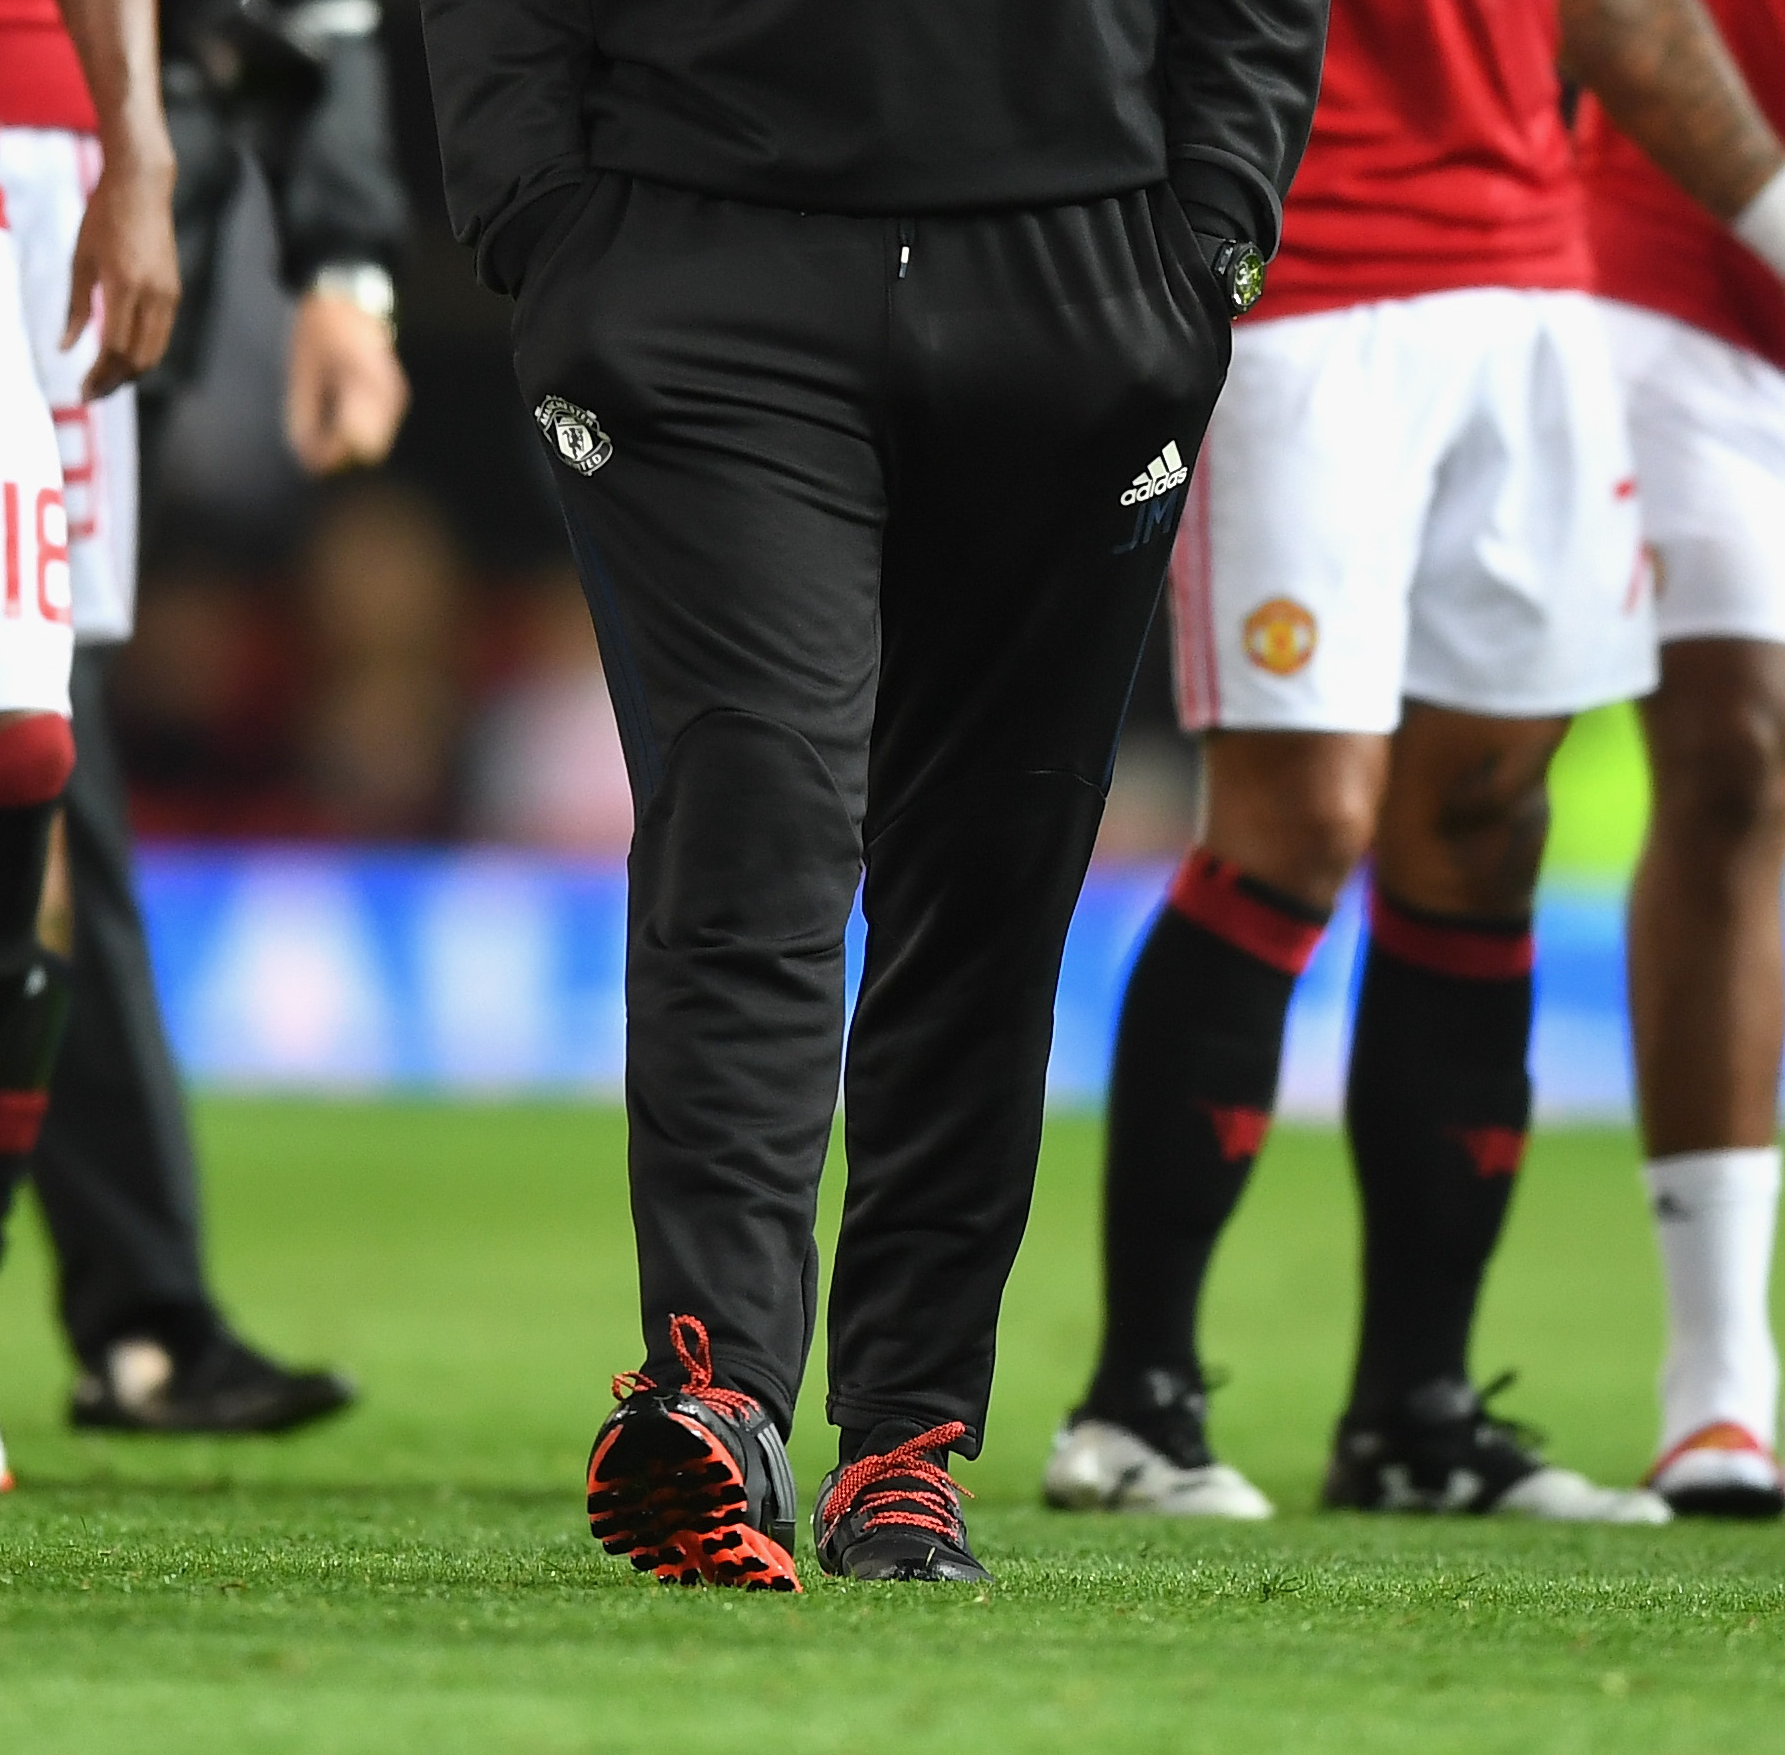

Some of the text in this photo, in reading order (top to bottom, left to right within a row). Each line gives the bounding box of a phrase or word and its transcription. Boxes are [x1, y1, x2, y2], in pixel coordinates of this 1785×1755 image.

[1119, 465, 1189, 507] adidas
[3, 481, 72, 624] 18
[1113, 488, 1180, 555] JM
